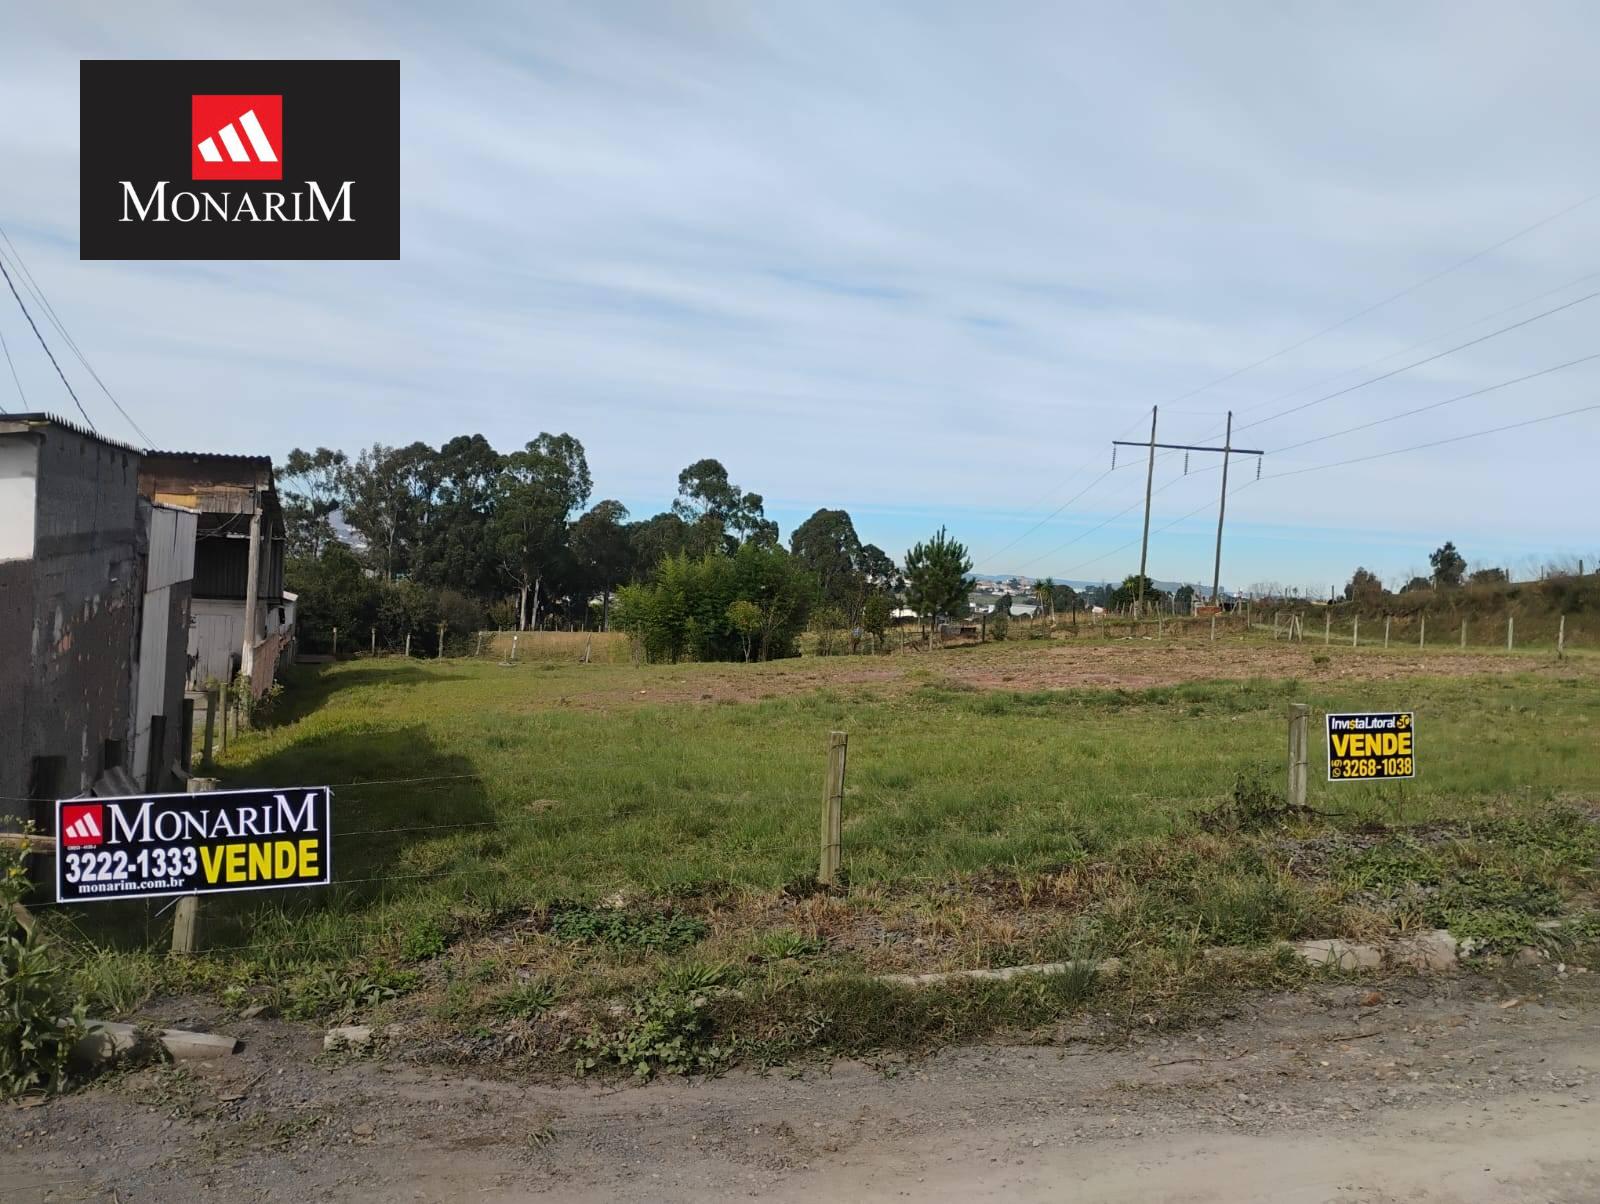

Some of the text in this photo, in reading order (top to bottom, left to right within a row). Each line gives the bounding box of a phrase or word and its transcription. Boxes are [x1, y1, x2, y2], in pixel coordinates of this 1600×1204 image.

[1331, 732, 1412, 757] VENDE
[1343, 757, 1412, 777] 3268-1038
[107, 792, 319, 845] MONARIM
[65, 847, 198, 884] 3222-1333
[199, 838, 319, 884] VENDE
[78, 876, 185, 894] monarim.com.br
